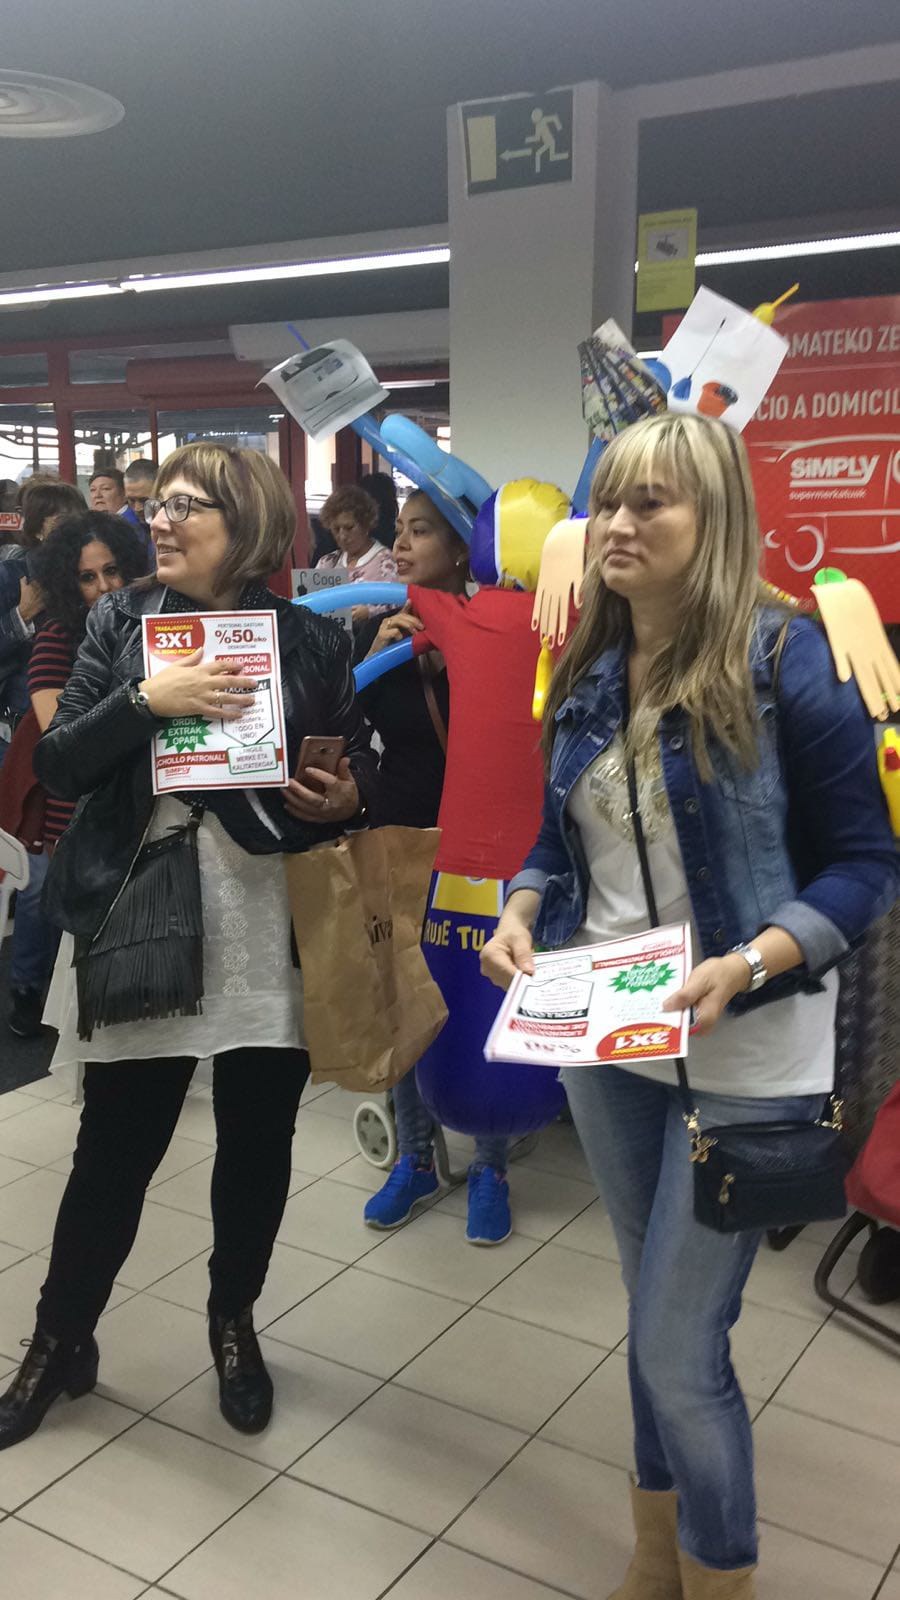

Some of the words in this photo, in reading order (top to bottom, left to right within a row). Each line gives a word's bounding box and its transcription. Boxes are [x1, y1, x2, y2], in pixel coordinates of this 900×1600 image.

[792, 394, 808, 419] A
[313, 571, 341, 588] Coge
[154, 631, 193, 649] 3X1
[168, 726, 202, 736] EXTRAK
[456, 926, 486, 952] TU
[614, 1031, 671, 1050] 3X1
